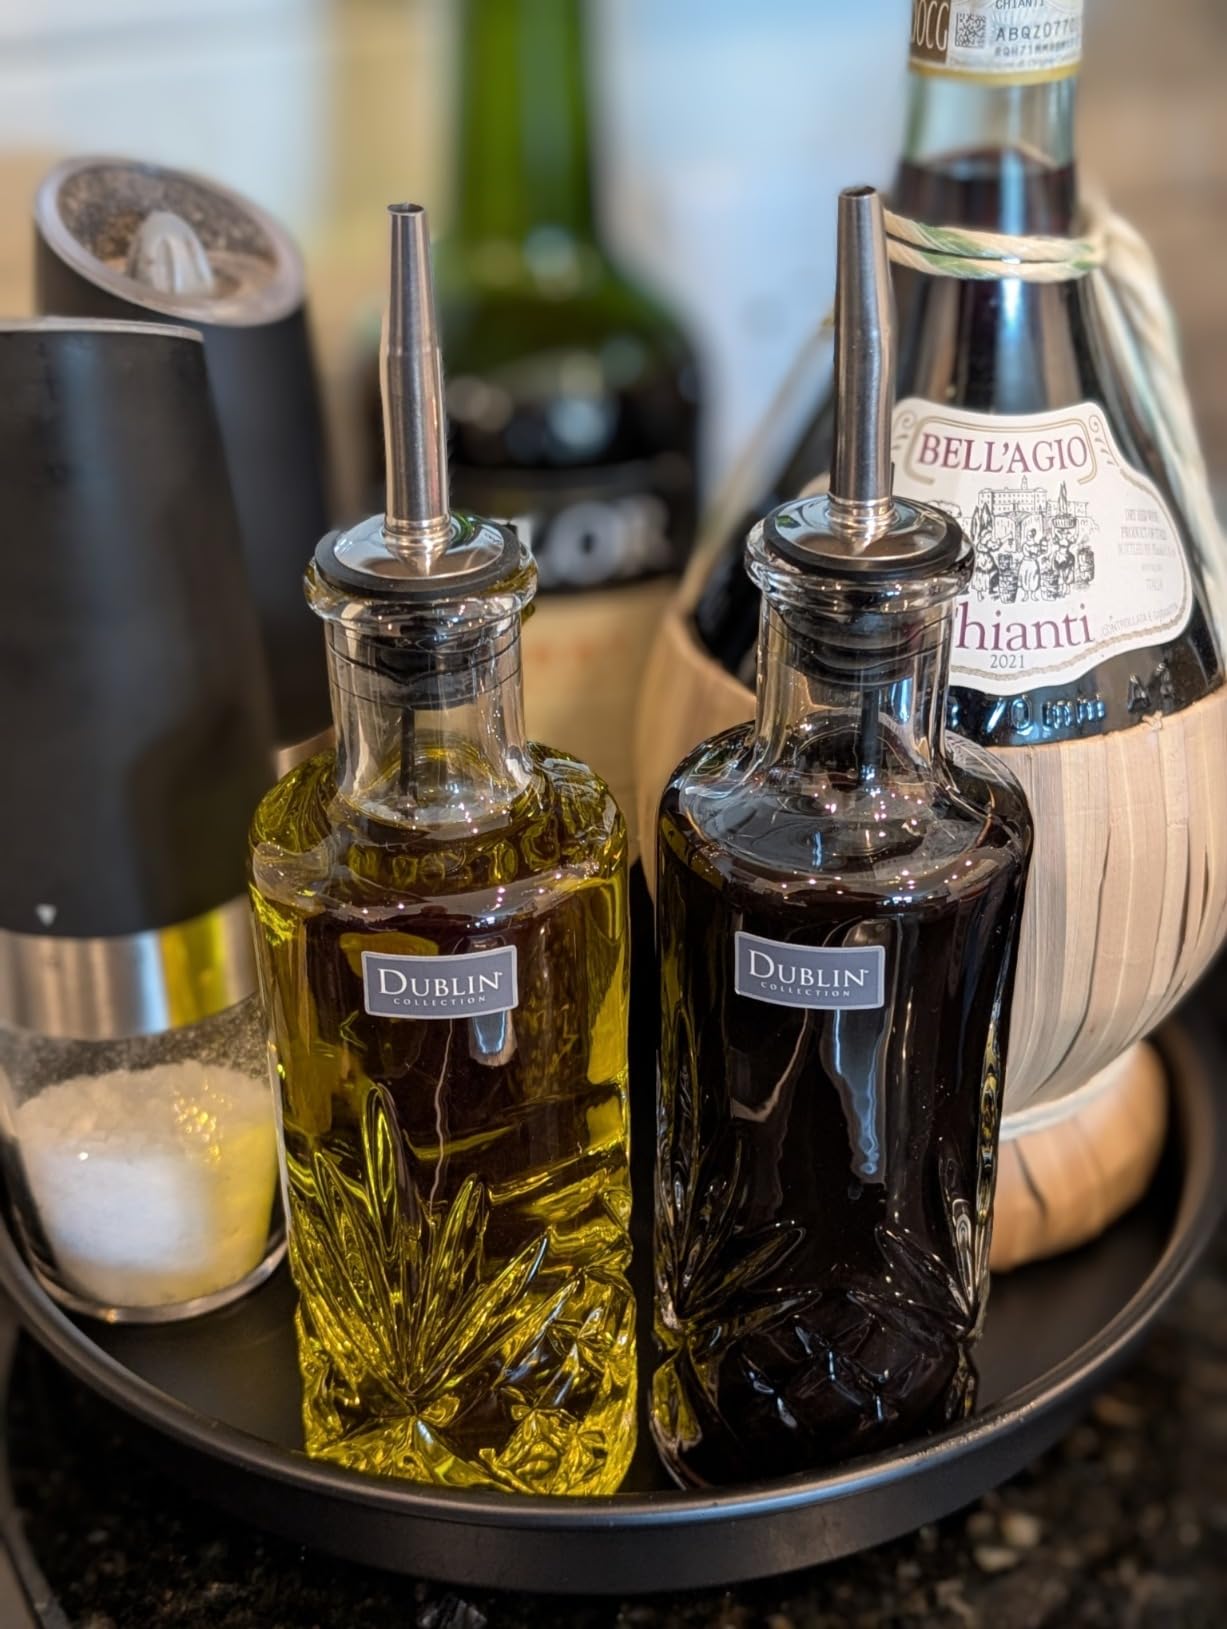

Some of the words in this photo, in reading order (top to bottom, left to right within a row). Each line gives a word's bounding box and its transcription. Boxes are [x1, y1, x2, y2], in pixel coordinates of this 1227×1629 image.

[917, 433, 1088, 474] BELL'AGIO
[955, 601, 1095, 651] hianti
[990, 654, 1025, 669] 2021
[377, 968, 502, 997] DUBLIN
[748, 949, 867, 988] DUBLIN
[393, 995, 487, 1007] COLLECTION
[760, 981, 851, 997] COLLECTION
